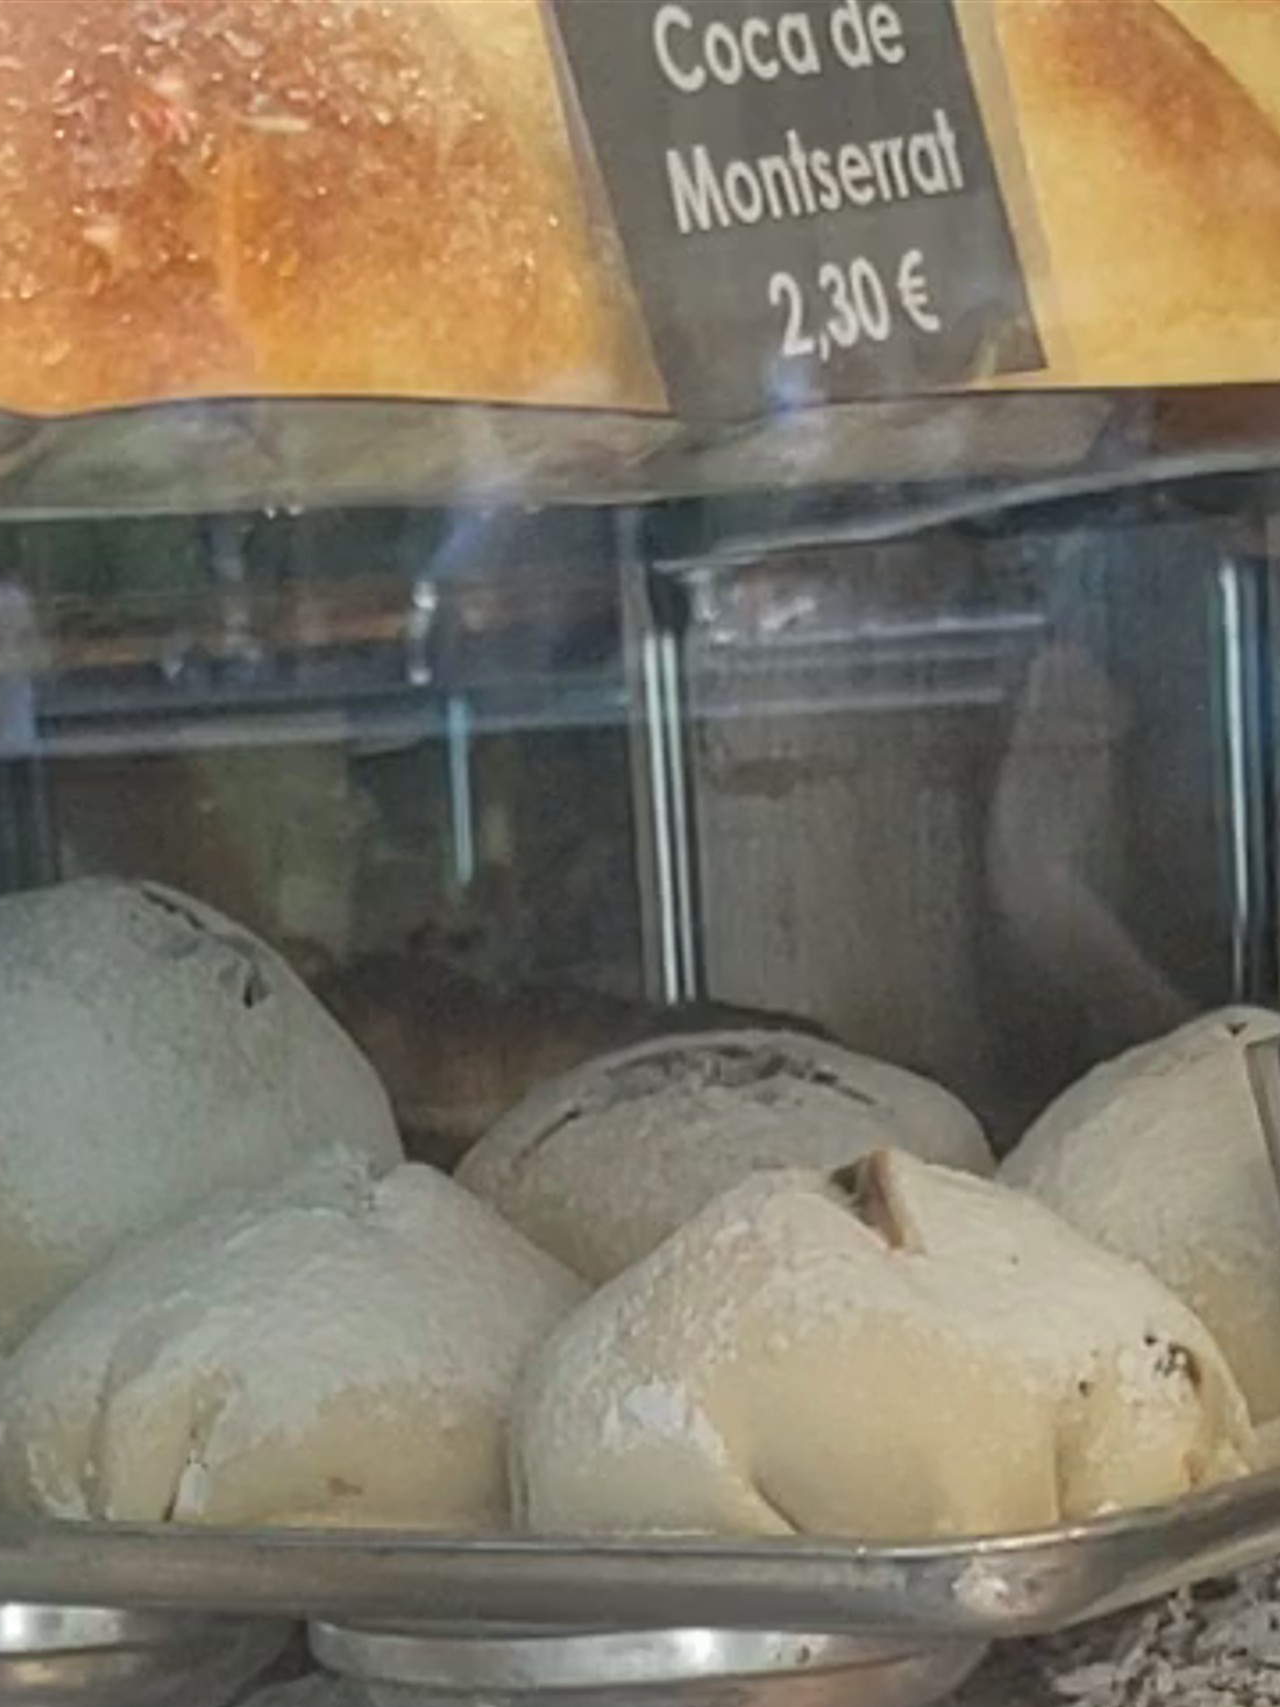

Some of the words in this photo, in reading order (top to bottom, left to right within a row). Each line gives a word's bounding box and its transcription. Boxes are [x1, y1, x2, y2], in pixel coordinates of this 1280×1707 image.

[653, 3, 820, 92] Coca
[830, 0, 906, 69] de
[666, 109, 964, 234] Montserrat
[769, 257, 891, 361] 2,30
[897, 249, 940, 332] €
